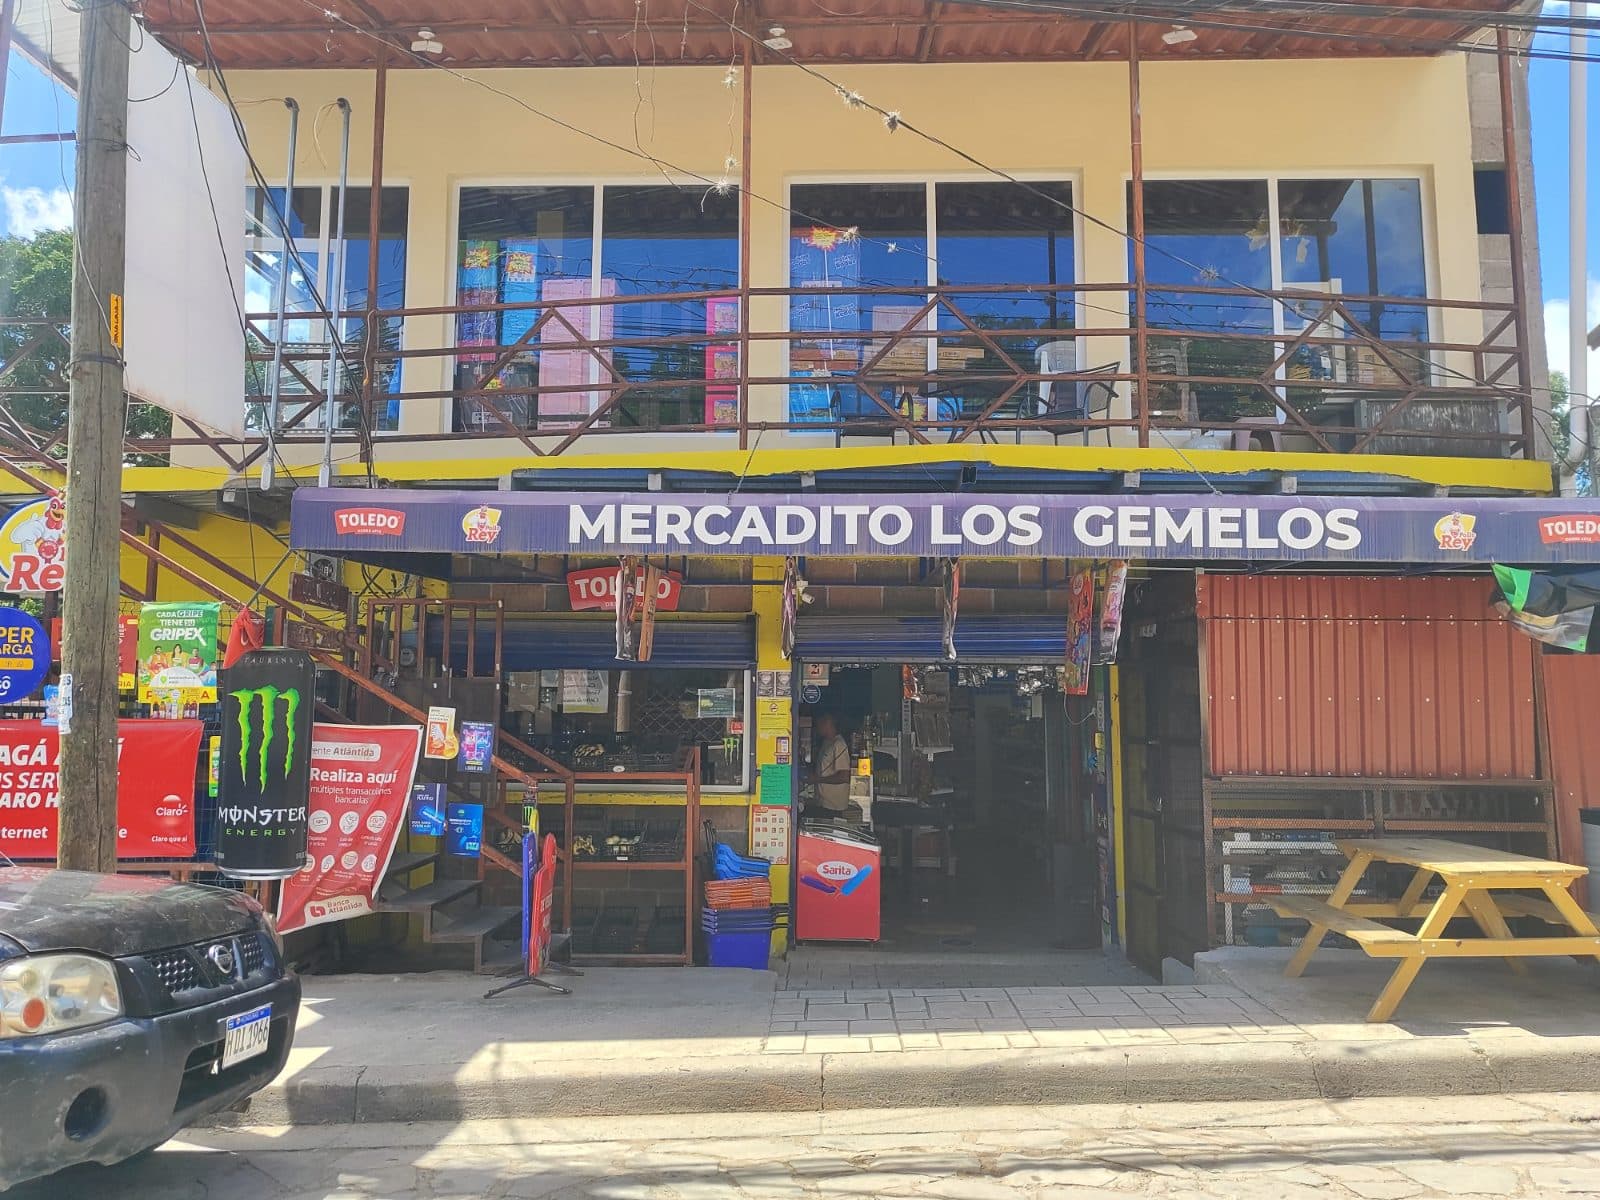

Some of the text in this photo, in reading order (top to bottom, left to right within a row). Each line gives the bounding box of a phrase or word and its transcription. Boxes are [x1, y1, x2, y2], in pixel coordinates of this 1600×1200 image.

[339, 513, 399, 529] TOLEDO
[569, 504, 1362, 550] MERCADITO LOS GEMELOS
[467, 527, 497, 543] Rey
[1441, 535, 1473, 550] Rey
[6, 555, 64, 591] Re
[177, 609, 203, 618] GRIPE
[160, 619, 185, 627] TIENE
[150, 627, 207, 646] GRIPEX
[333, 746, 375, 757] Atlántida
[310, 767, 400, 786] Realiza aquí
[310, 785, 344, 796] múltiples
[335, 795, 369, 805] bancarias
[155, 804, 184, 817] Claro
[225, 828, 297, 837] ENERGY
[151, 835, 167, 843] Claro
[822, 864, 851, 876] Sarita
[327, 898, 350, 908] Banco
